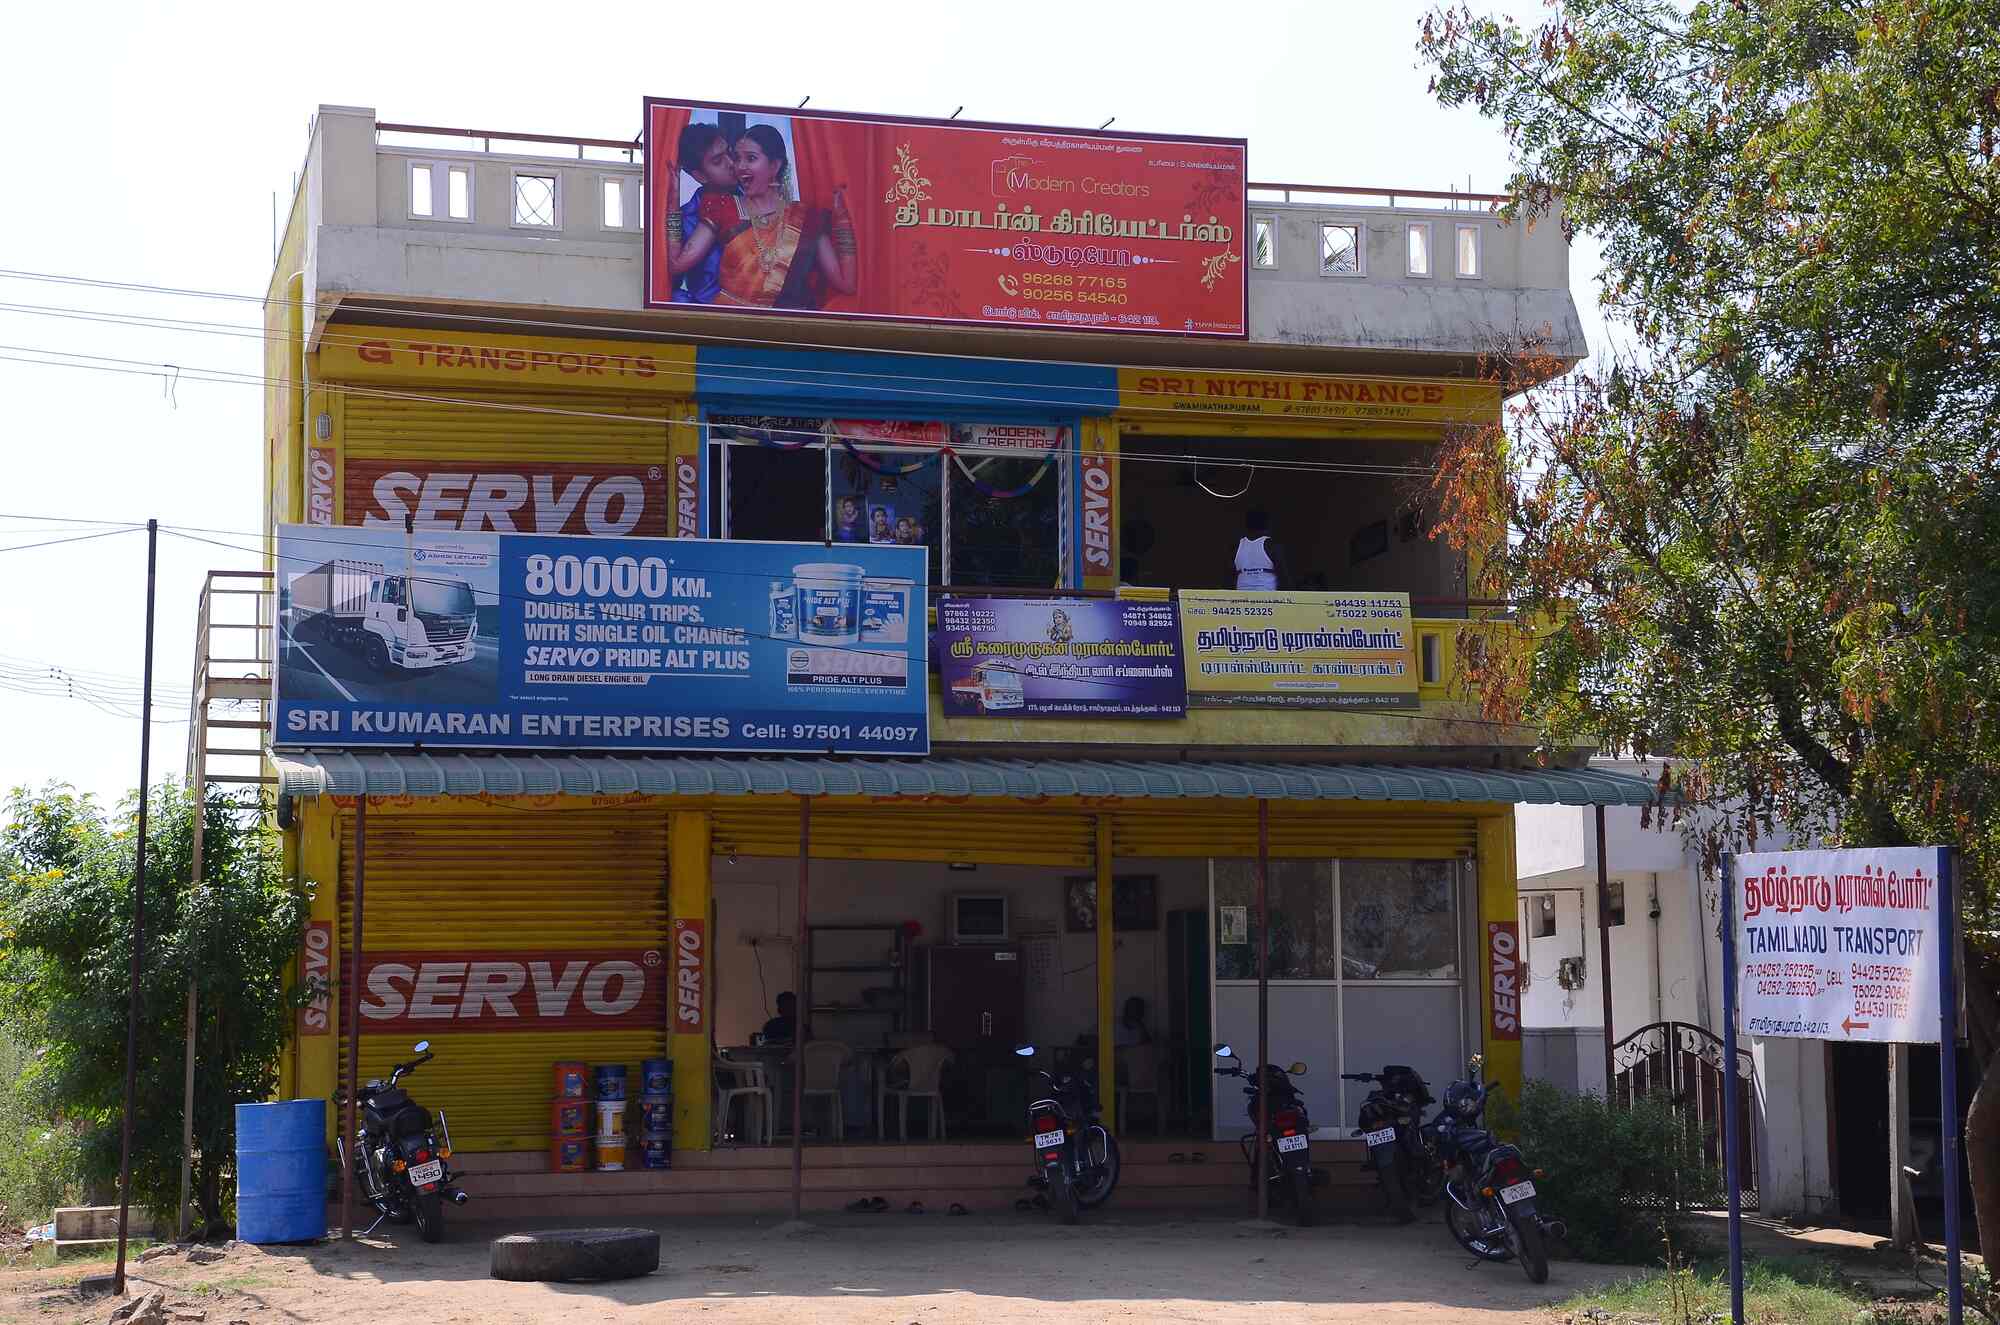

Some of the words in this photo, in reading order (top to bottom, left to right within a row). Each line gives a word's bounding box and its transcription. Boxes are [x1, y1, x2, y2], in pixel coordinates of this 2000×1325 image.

[1010, 171, 1075, 193] Modern
[1081, 177, 1151, 197] Creators
[894, 200, 920, 231] தி
[928, 203, 1042, 232] மாடர்ன்
[1050, 208, 1232, 243] கிரியேட்டர்ஸ்
[1023, 273, 1073, 286] 96268
[1078, 276, 1127, 289] 77165
[1023, 288, 1074, 302] 90256
[1078, 292, 1128, 305] 54540
[358, 342, 393, 365] G
[408, 344, 657, 378] TRANSPORTS
[1137, 376, 1194, 396] SRI
[1206, 379, 1292, 401] NITHI
[1303, 382, 1445, 405] FINANCE
[987, 427, 1046, 438] MODERN
[311, 459, 333, 525] ERVO
[363, 471, 645, 535] SERVO
[1083, 472, 1111, 569] SERVO
[672, 577, 712, 598] KM.
[524, 601, 595, 620] DOUBLE
[599, 603, 646, 622] YOUR
[650, 604, 705, 623] TRIPS.
[1212, 607, 1242, 615] 94425
[1335, 609, 1368, 618] 75022
[524, 623, 570, 641] WITH
[575, 624, 639, 643] SINGLE
[642, 626, 670, 644] OIL
[674, 627, 750, 646] CHANGE.
[1197, 626, 1279, 653] தமிழ்நாடு
[1282, 626, 1404, 652] டிரான்ஸ்போர்ட்
[524, 646, 600, 667] SERVO
[605, 649, 661, 668] PRIDE
[665, 650, 698, 668] ALT
[703, 651, 750, 670] PLUS
[530, 674, 550, 682] LONG
[551, 674, 575, 682] DRAIN
[577, 675, 602, 683] DIESEL
[604, 675, 631, 683] ENGINE
[633, 675, 645, 683] OIL
[813, 675, 839, 683] PRIDE
[841, 676, 857, 684] ALT
[859, 677, 882, 685] PLUS
[288, 709, 339, 731] SRI
[351, 711, 511, 735] KUMARAN
[522, 714, 730, 738] ENTERPRISES
[742, 724, 786, 739] Cell:
[793, 724, 850, 740] 97501
[858, 725, 918, 741] 44097
[1744, 865, 1831, 921] தமிழ்நாடு
[1835, 864, 1932, 914] டிரான்ஸ்போர்ட்
[1747, 925, 1827, 954] TAMILNADU
[1833, 927, 1924, 956] TRANSPORT
[359, 961, 645, 1020] SERVO
[678, 929, 700, 1026] SERVO
[1493, 931, 1516, 1033] SERVO
